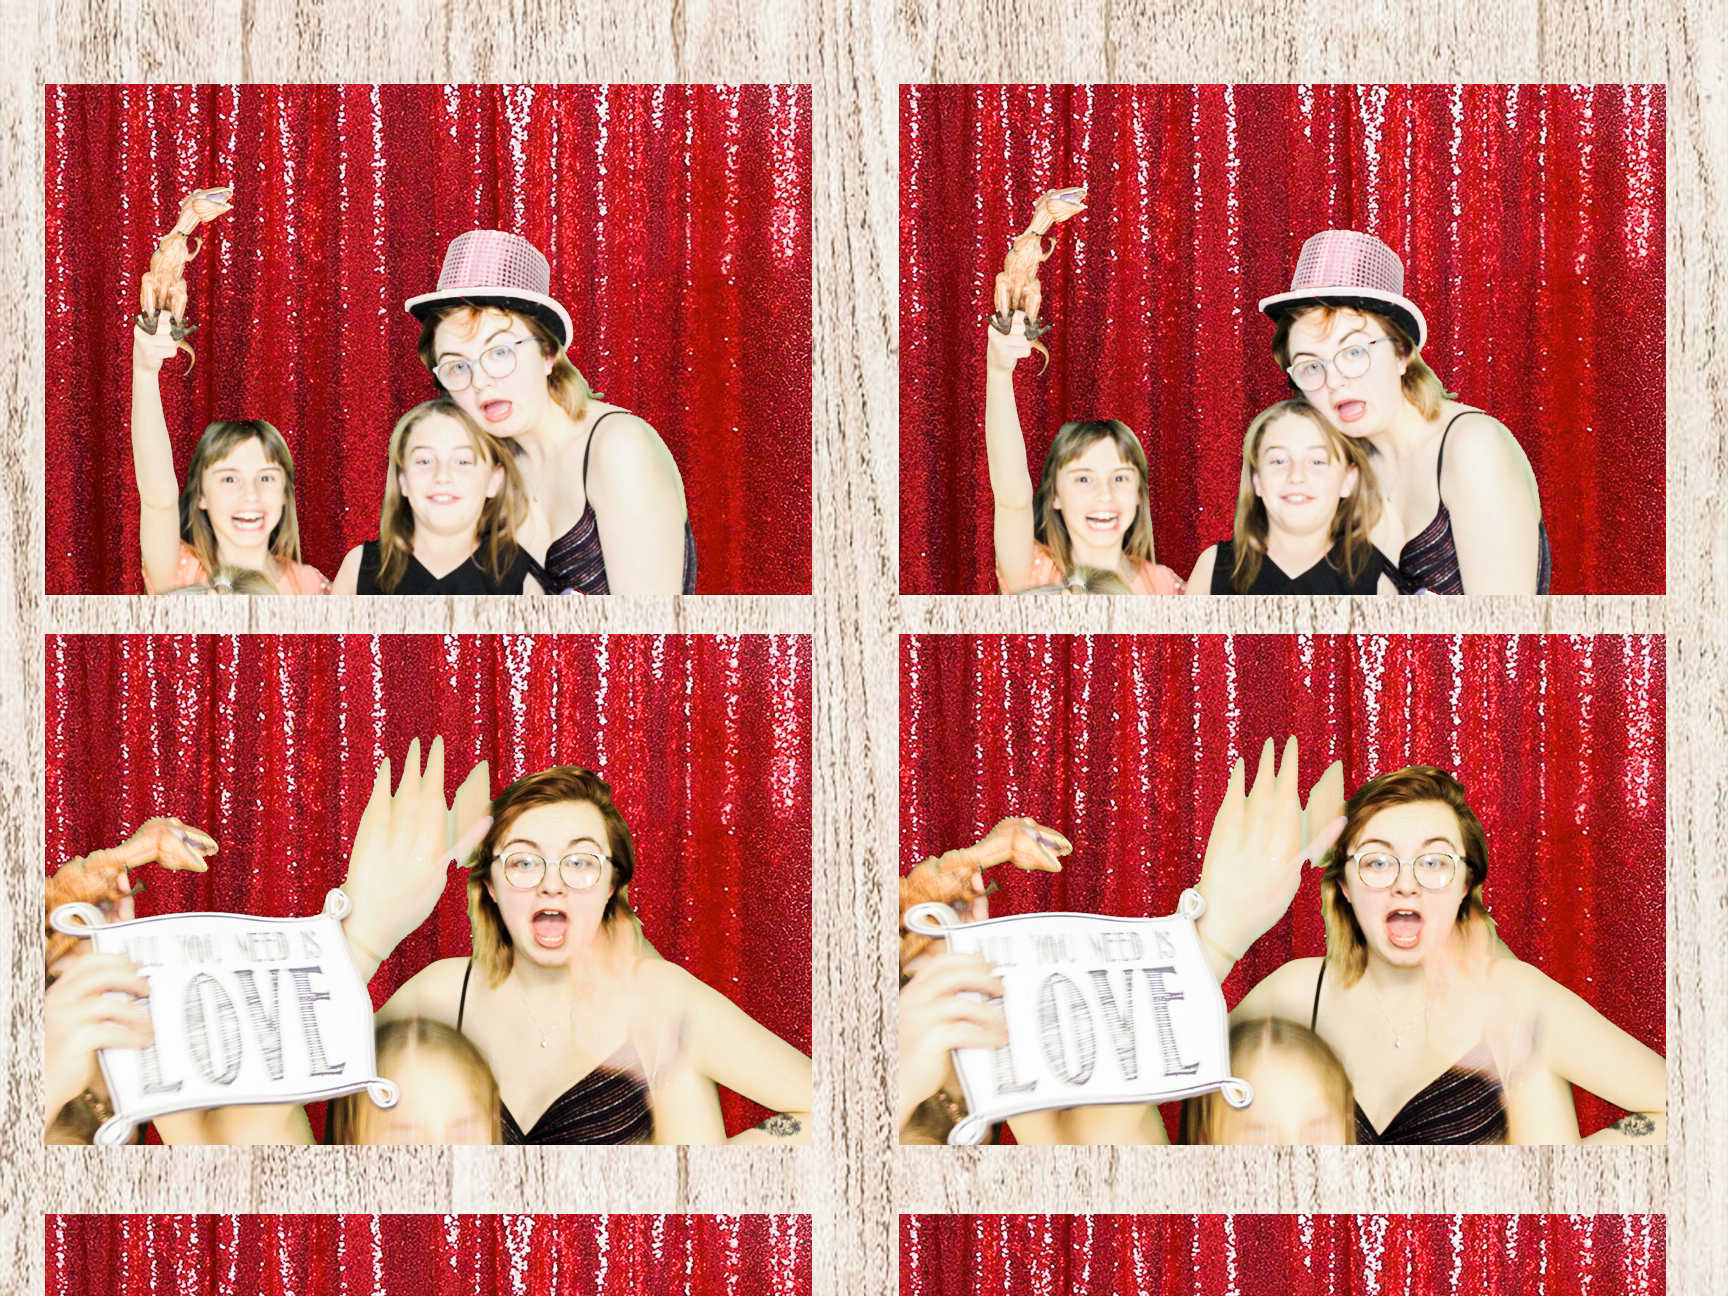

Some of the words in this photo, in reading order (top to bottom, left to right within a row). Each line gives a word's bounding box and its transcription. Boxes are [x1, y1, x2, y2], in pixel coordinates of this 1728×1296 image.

[232, 930, 291, 963] NEED
[299, 929, 323, 960] IS
[1086, 930, 1145, 963] NEED
[1153, 929, 1177, 960] IS
[131, 965, 347, 1096] LOVE
[985, 965, 1201, 1096] LOVE
